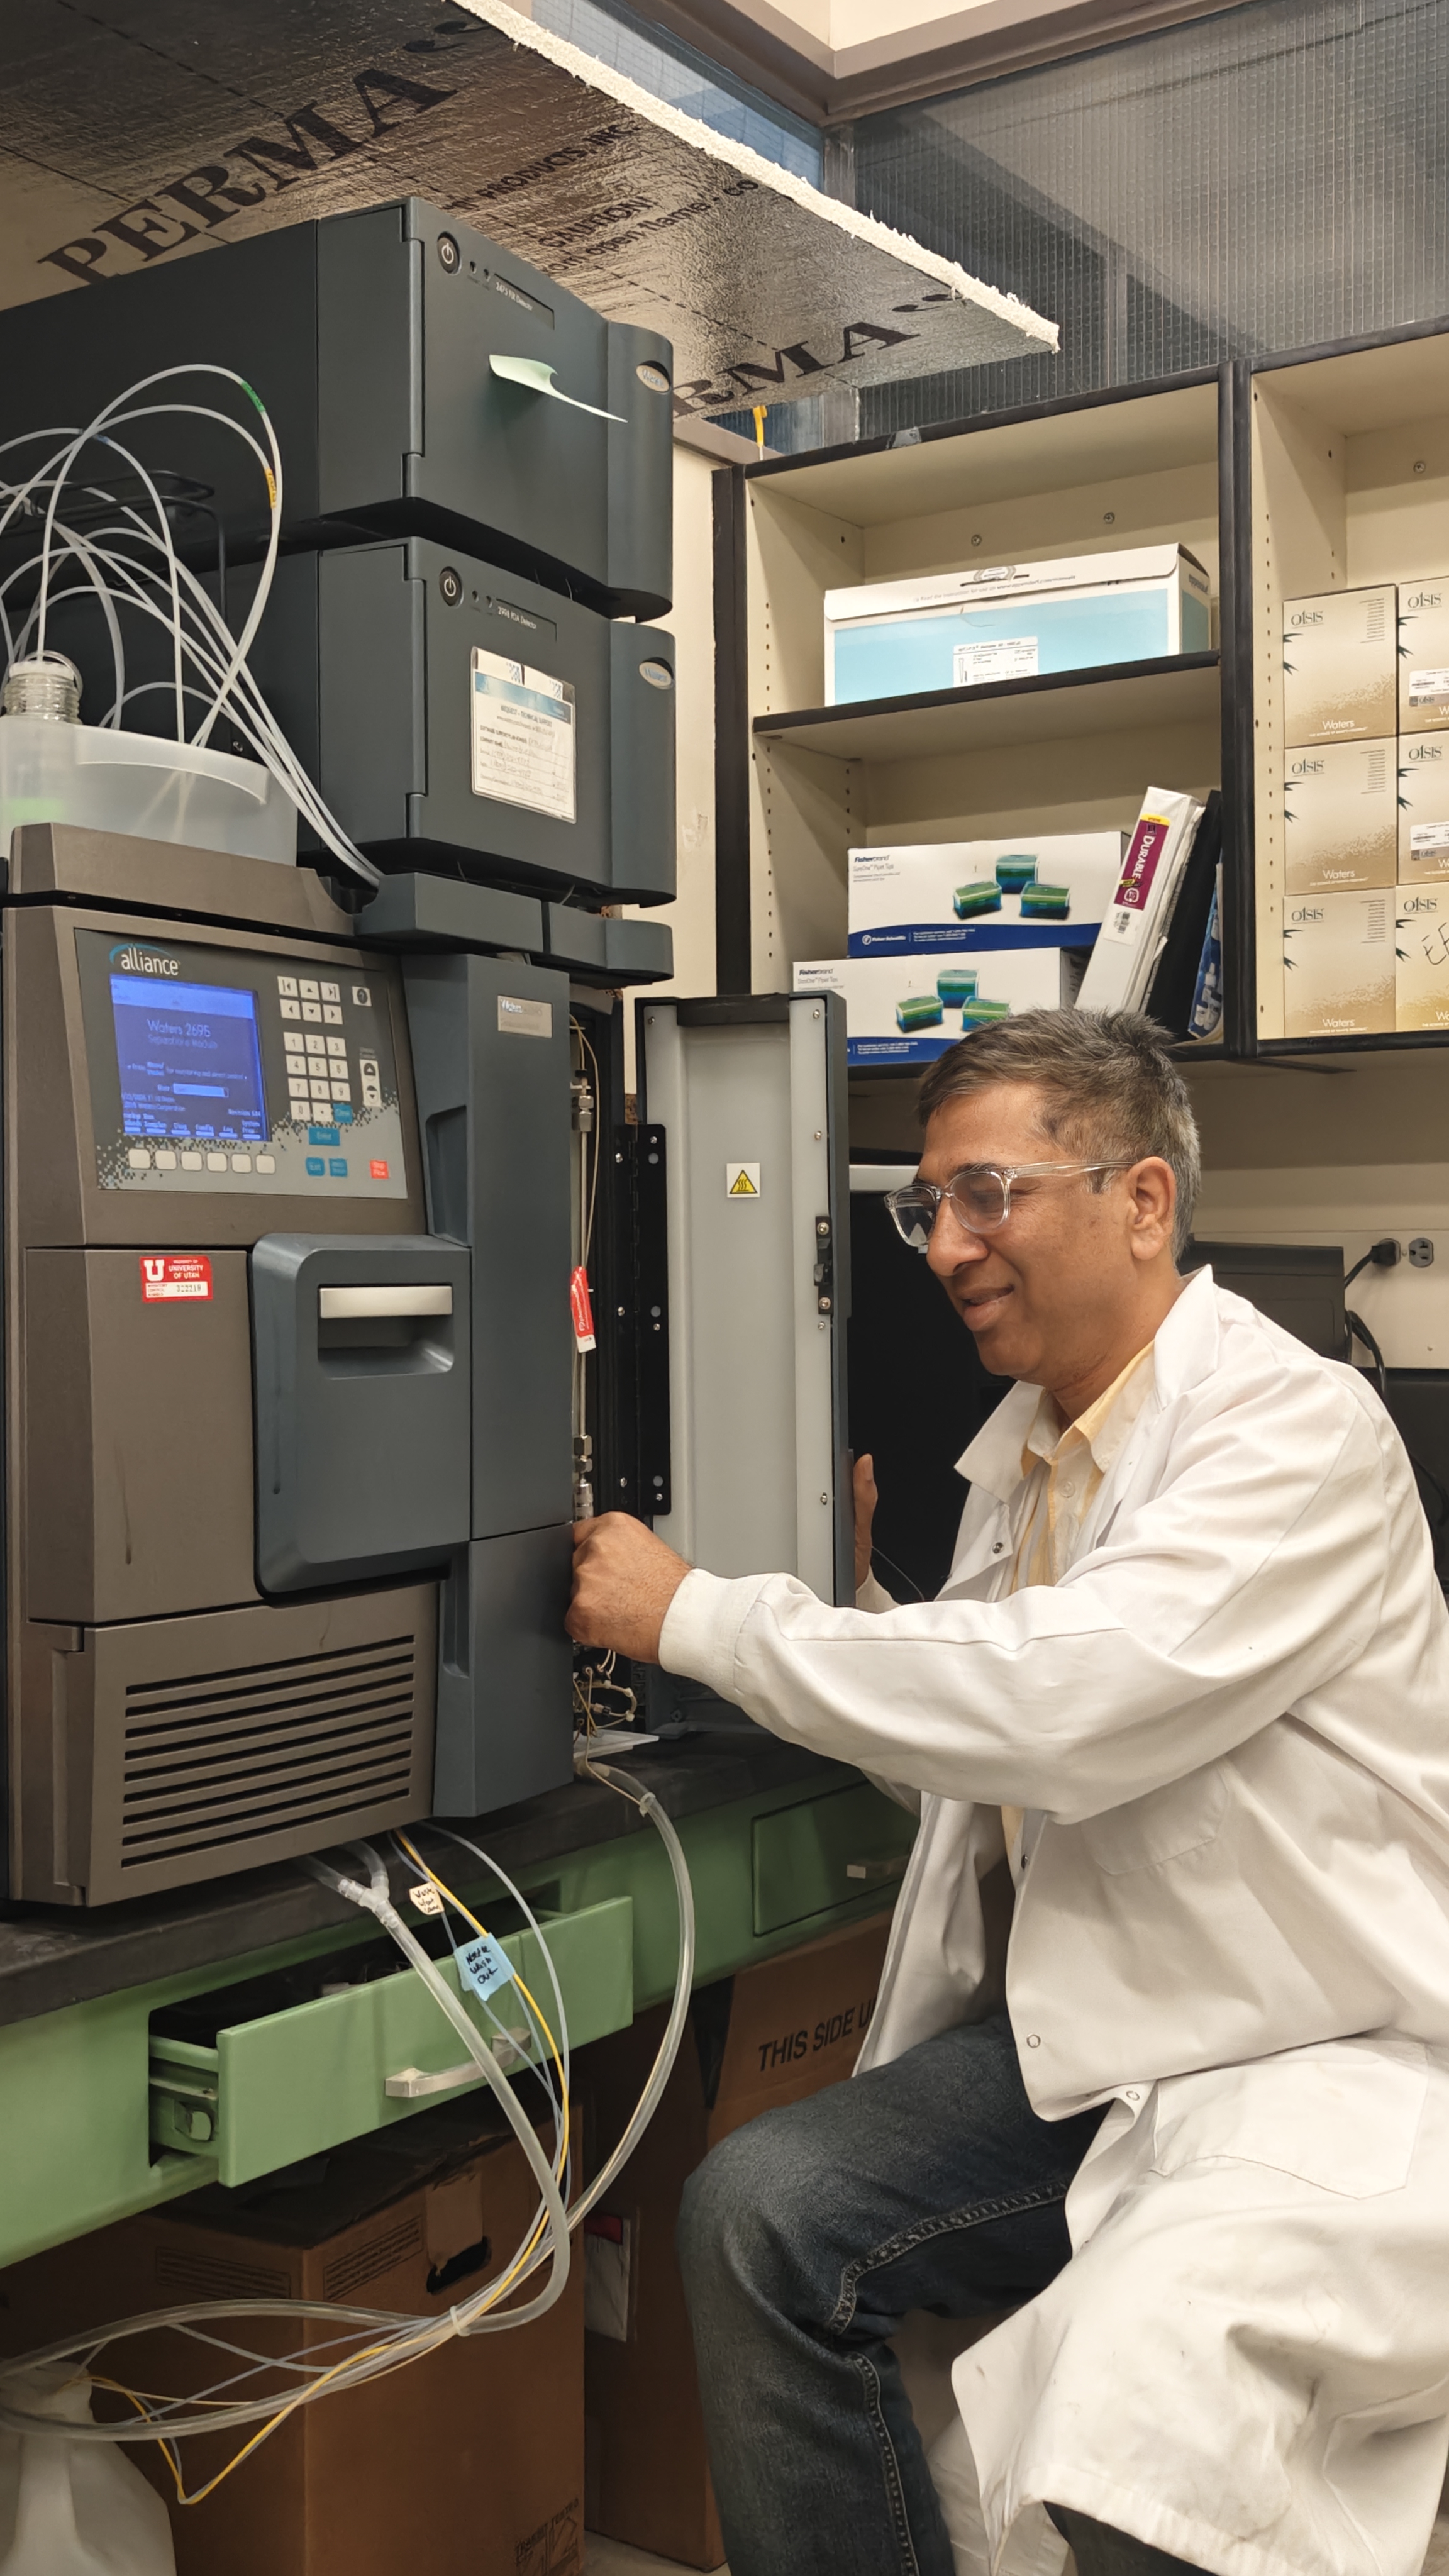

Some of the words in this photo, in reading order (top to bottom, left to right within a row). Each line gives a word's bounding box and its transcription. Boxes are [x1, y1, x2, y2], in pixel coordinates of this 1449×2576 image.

[1323, 719, 1355, 730] Waters
[1132, 835, 1156, 879] DURABLE
[1323, 869, 1355, 880] Waters
[121, 947, 179, 976] alliance
[798, 968, 834, 976] Fisherbrand
[147, 1019, 183, 1035] Waters
[185, 1023, 211, 1038] 2695
[1323, 1018, 1355, 1028] Waters
[758, 2029, 808, 2072] THIS
[813, 2006, 856, 2052] SIDE
